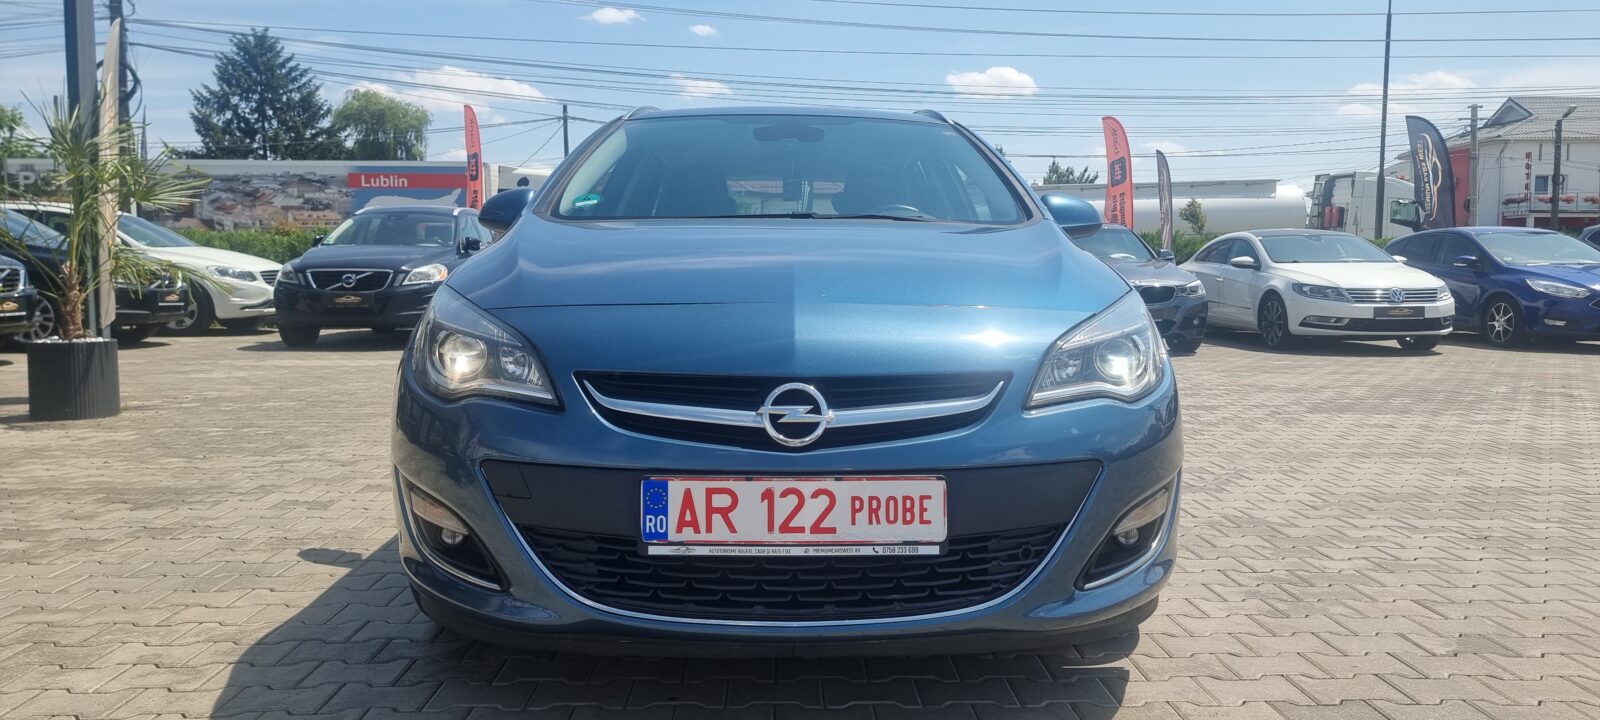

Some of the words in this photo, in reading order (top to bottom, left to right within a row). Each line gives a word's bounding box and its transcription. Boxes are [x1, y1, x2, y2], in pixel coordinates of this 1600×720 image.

[361, 175, 408, 187] Lublin
[675, 487, 739, 534] AR
[761, 487, 837, 534] 122
[850, 495, 933, 526] PROBE
[646, 515, 666, 533] RO
